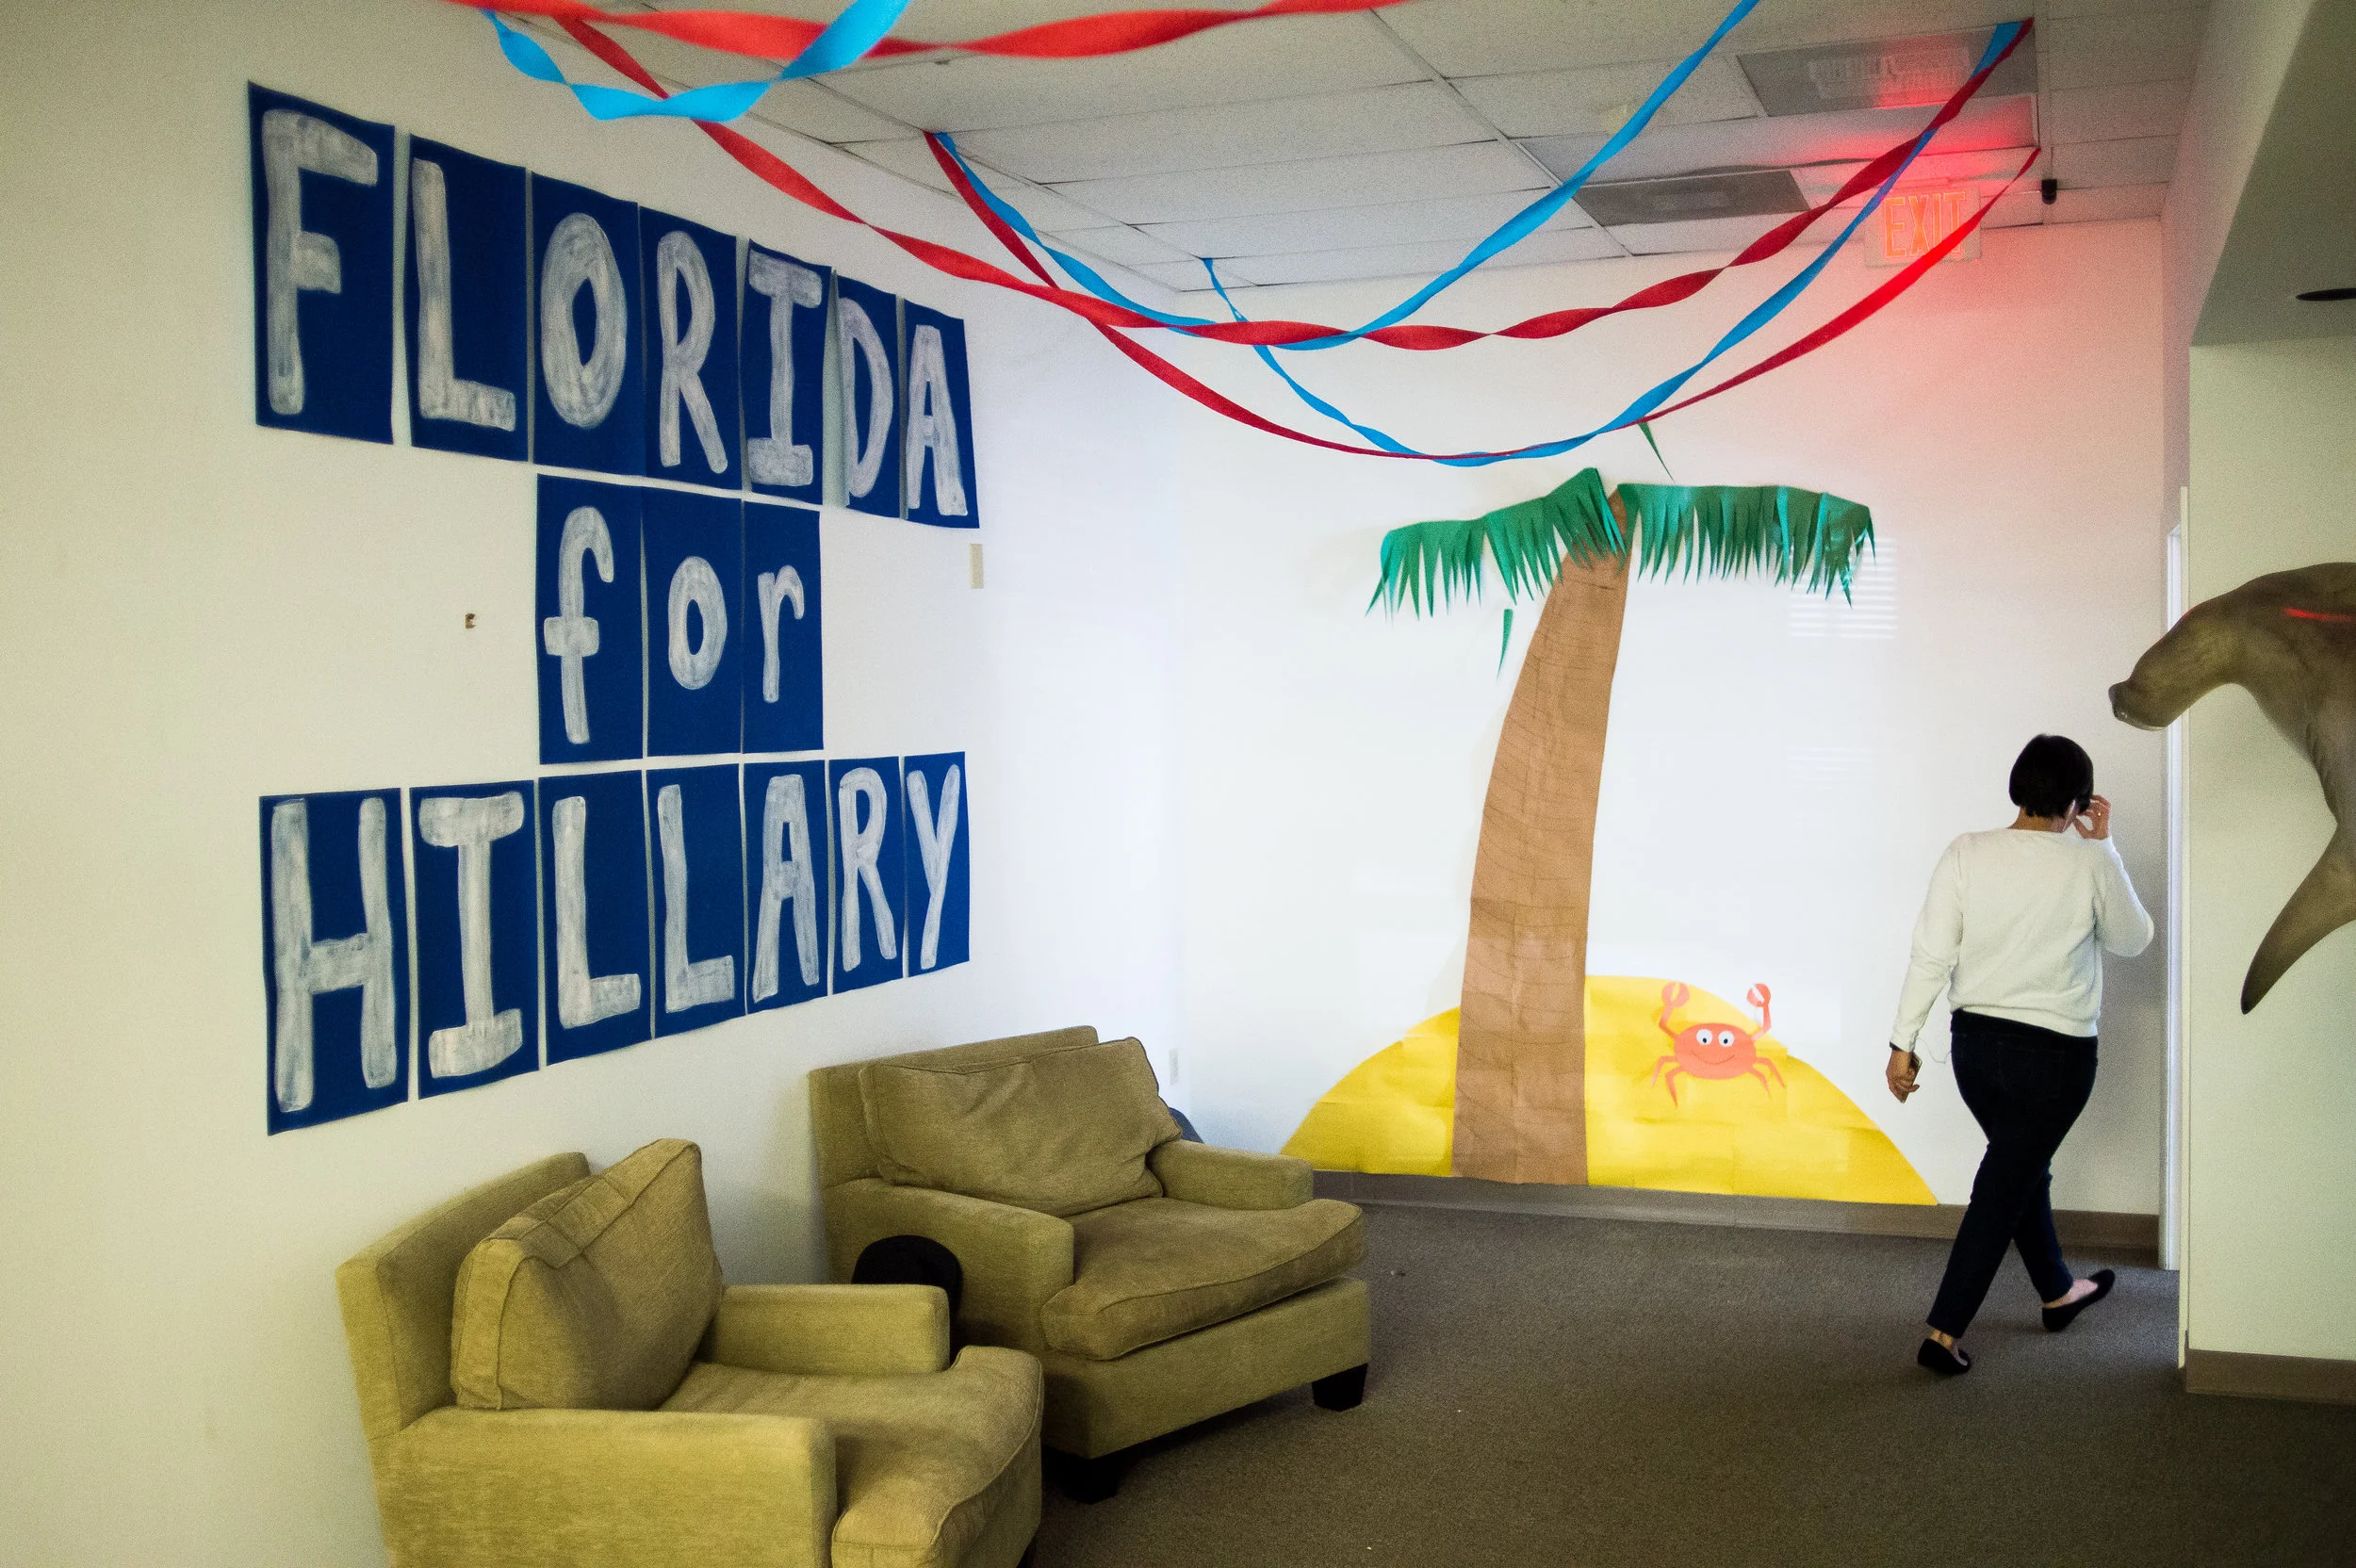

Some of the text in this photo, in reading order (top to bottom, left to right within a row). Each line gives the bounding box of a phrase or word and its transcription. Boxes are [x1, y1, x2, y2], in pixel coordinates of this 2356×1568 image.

[261, 109, 969, 516] FLORIDA
[1885, 191, 1967, 257] EXIT
[544, 506, 805, 744] for
[270, 764, 961, 1113] HILLARY
